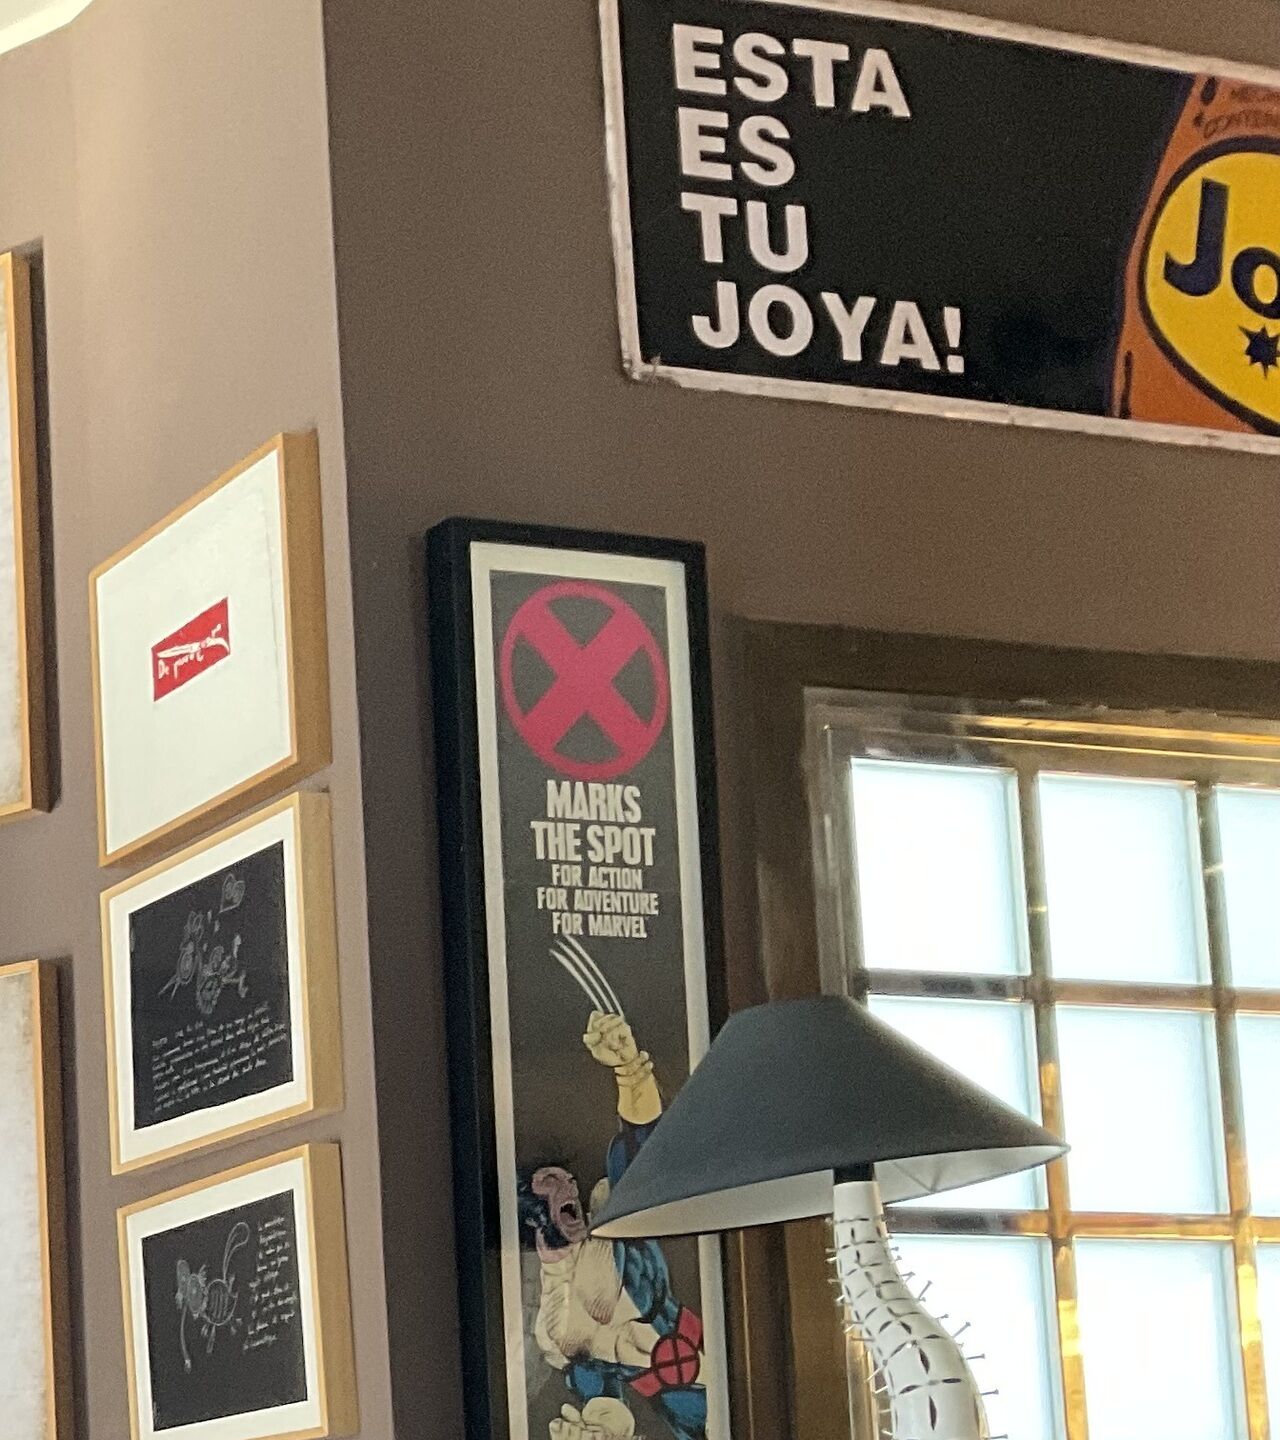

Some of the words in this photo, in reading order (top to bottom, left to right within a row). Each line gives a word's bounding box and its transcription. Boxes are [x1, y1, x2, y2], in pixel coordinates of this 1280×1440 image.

[671, 22, 912, 118] ESTA
[676, 105, 797, 187] ES
[680, 190, 810, 273] TU
[691, 279, 966, 375] JOYA!
[547, 779, 642, 824] MARKS
[530, 820, 582, 862] THE
[586, 824, 656, 866] SPOT
[551, 863, 582, 887] FOR
[588, 866, 643, 890] ACTION
[537, 886, 569, 910] FOR
[574, 888, 659, 916] ADVENTURE
[552, 911, 583, 935] FOR
[588, 913, 648, 939] MARVEL
